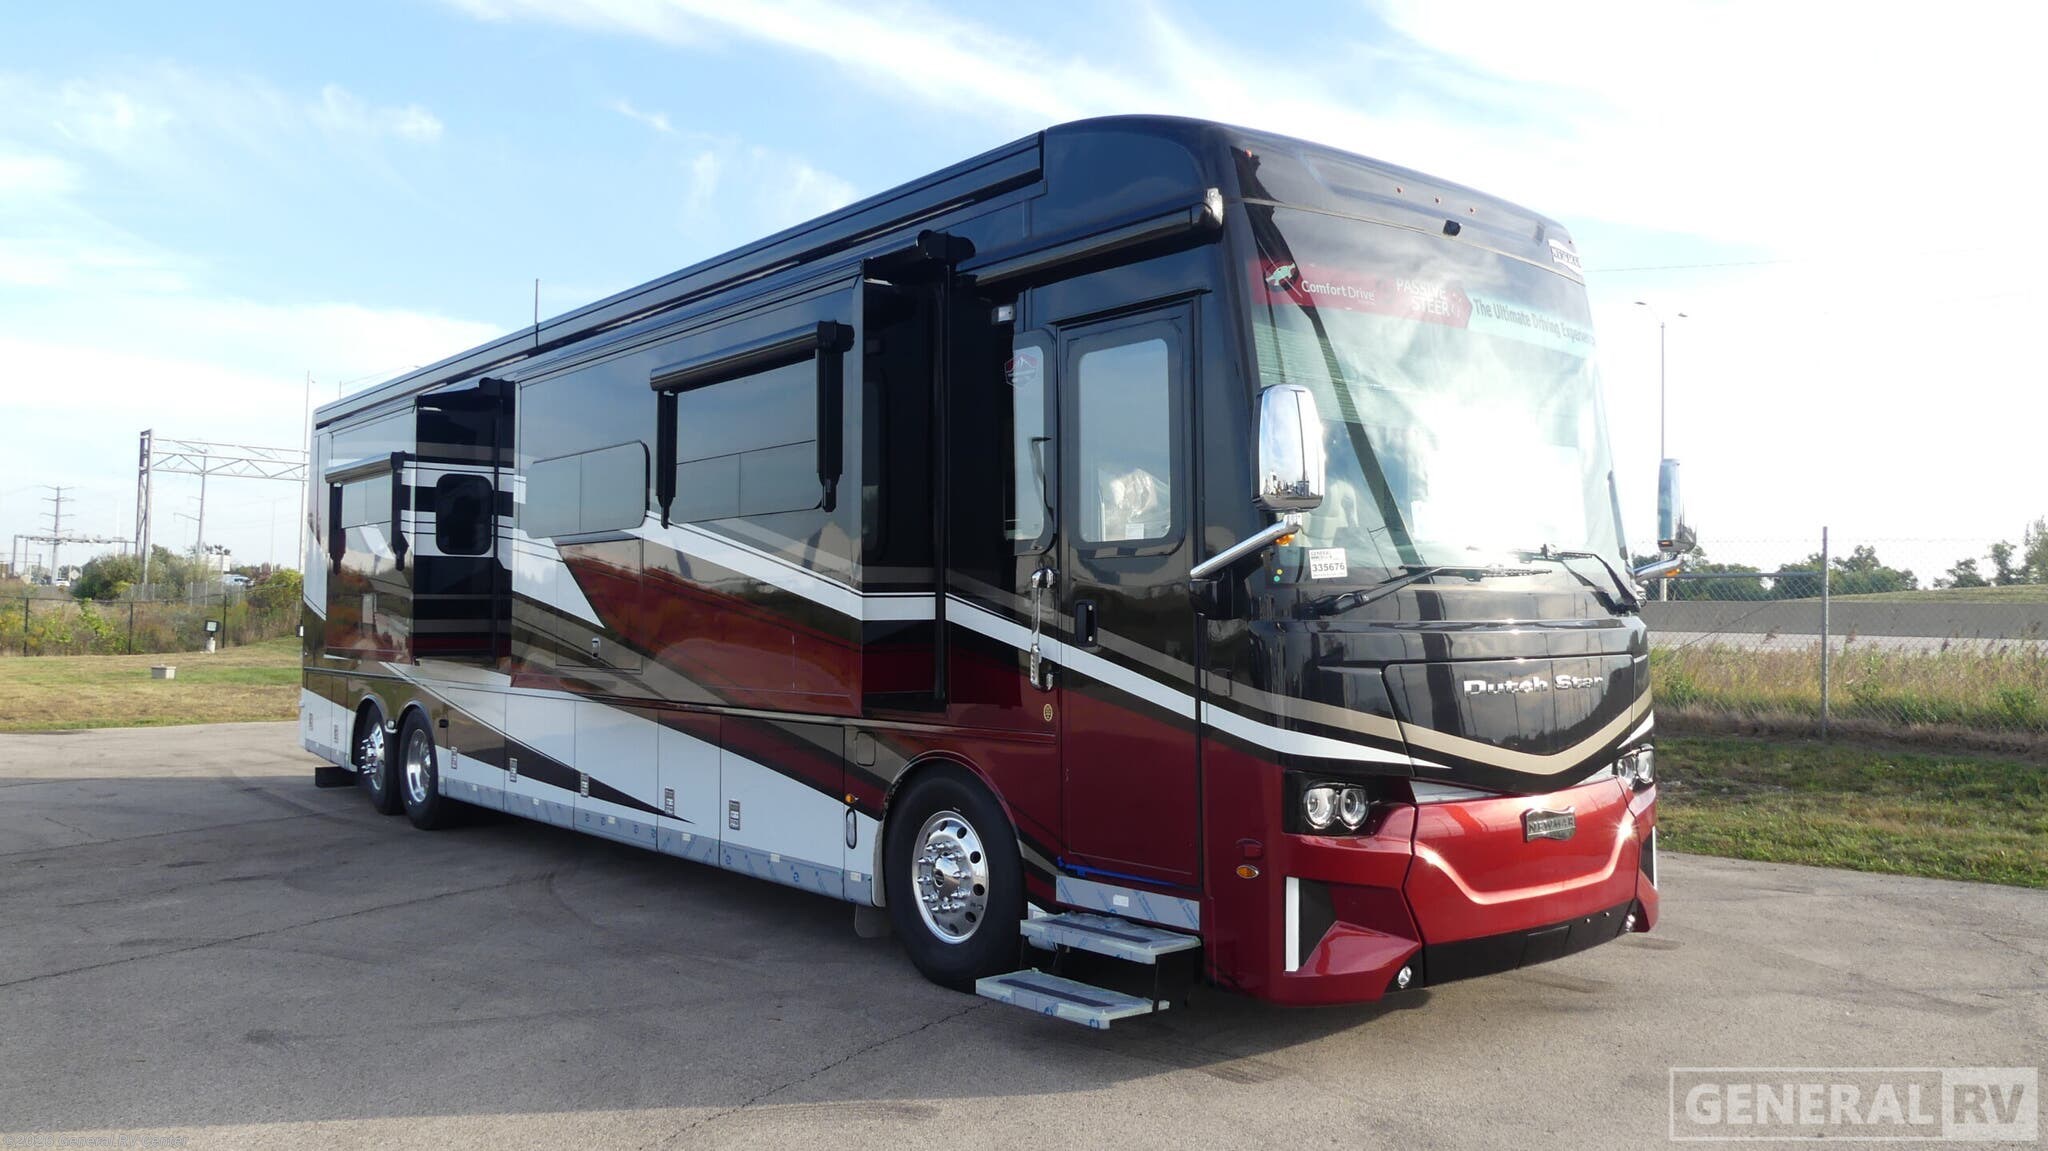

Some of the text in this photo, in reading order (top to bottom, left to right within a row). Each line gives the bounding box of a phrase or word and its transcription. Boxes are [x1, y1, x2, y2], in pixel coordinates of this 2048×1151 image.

[1301, 281, 1376, 299] Comfort Drive
[1396, 279, 1447, 300] PASSIVE
[1411, 299, 1450, 317] STEER
[1473, 298, 1493, 318] The
[1493, 303, 1532, 328] Ultimate
[1531, 313, 1561, 339] Driving
[1311, 562, 1346, 572] 335676
[1463, 674, 1604, 695] Dutch Star
